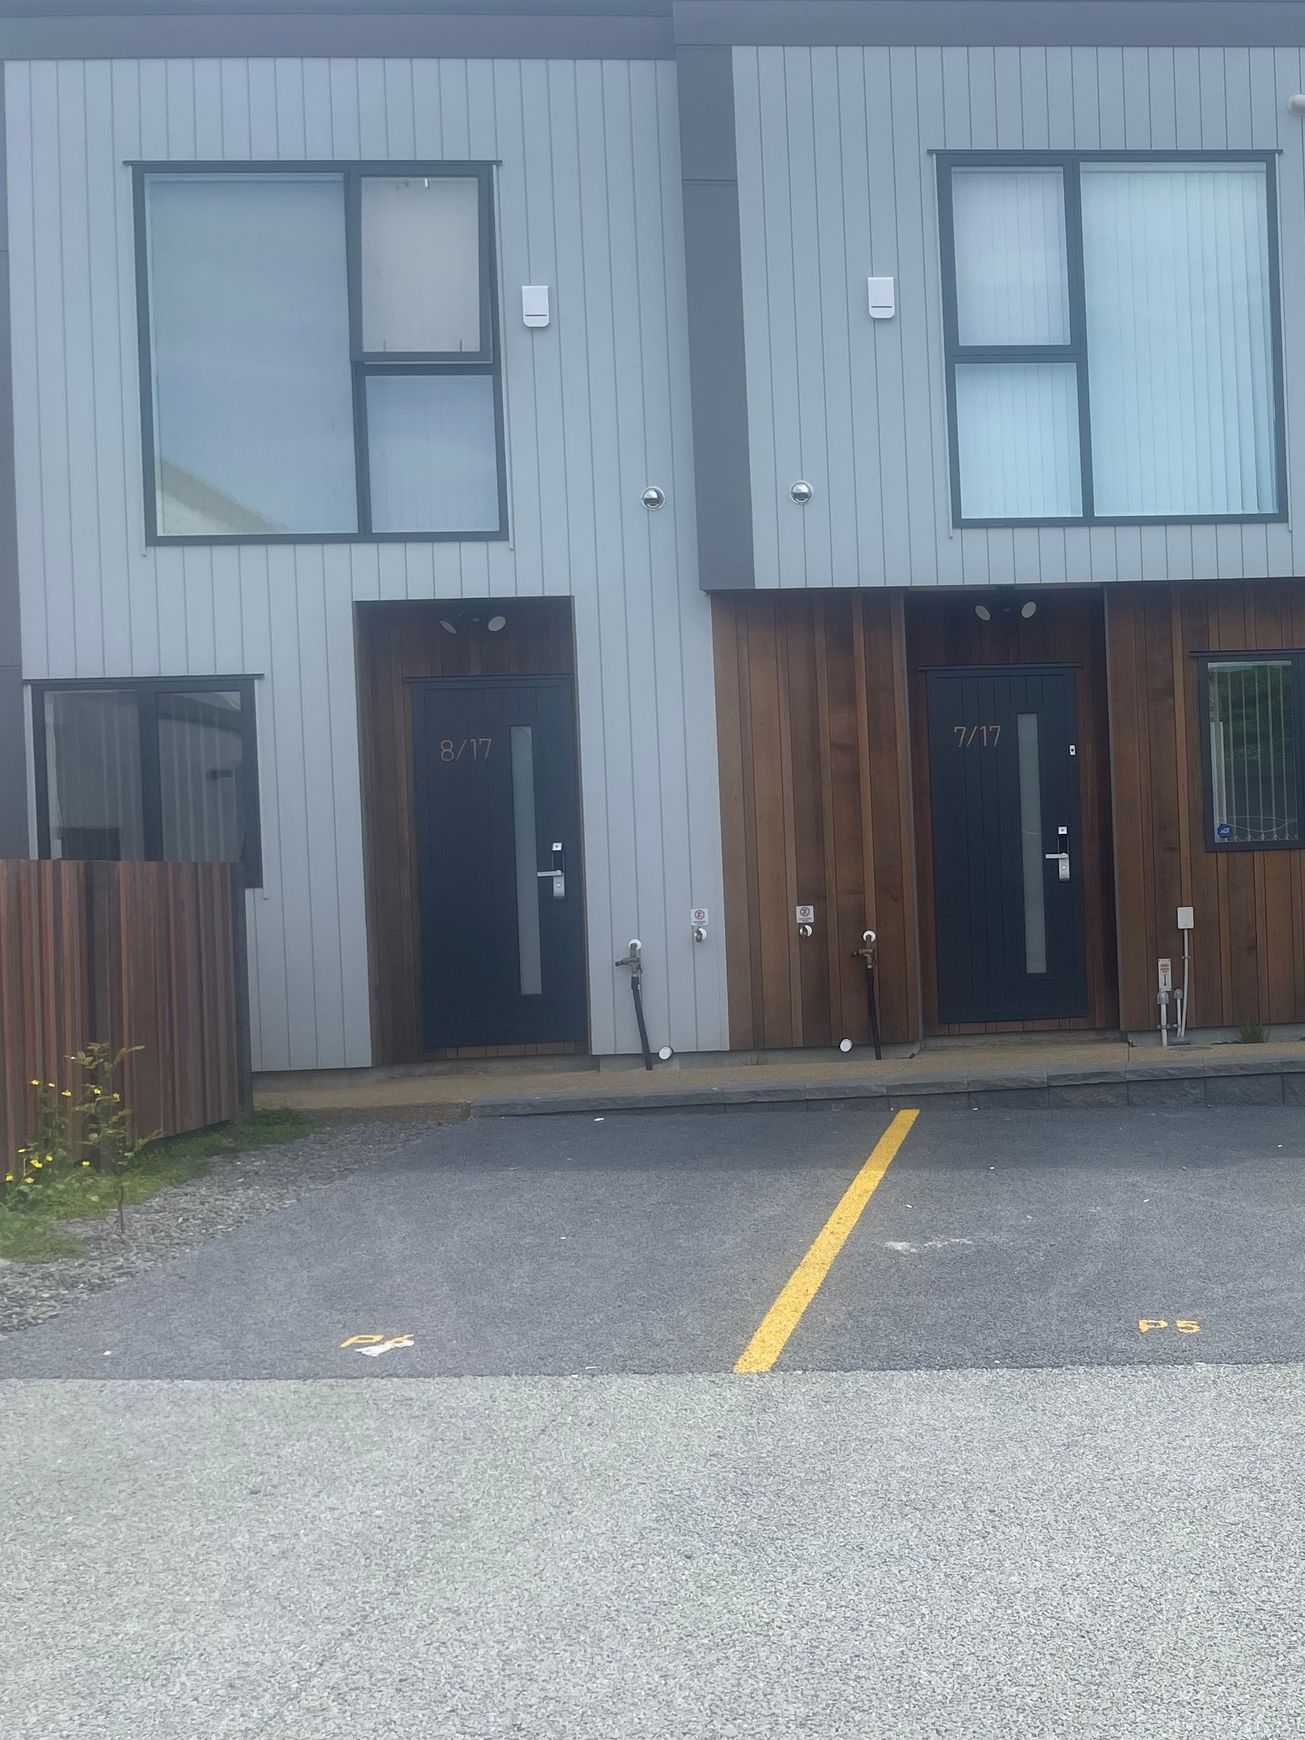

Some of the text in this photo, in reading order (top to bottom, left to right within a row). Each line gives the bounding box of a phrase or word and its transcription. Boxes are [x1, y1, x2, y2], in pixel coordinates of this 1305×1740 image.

[953, 725, 1001, 748] 7/17
[440, 738, 492, 762] 8/17
[1138, 1319, 1201, 1334] P5
